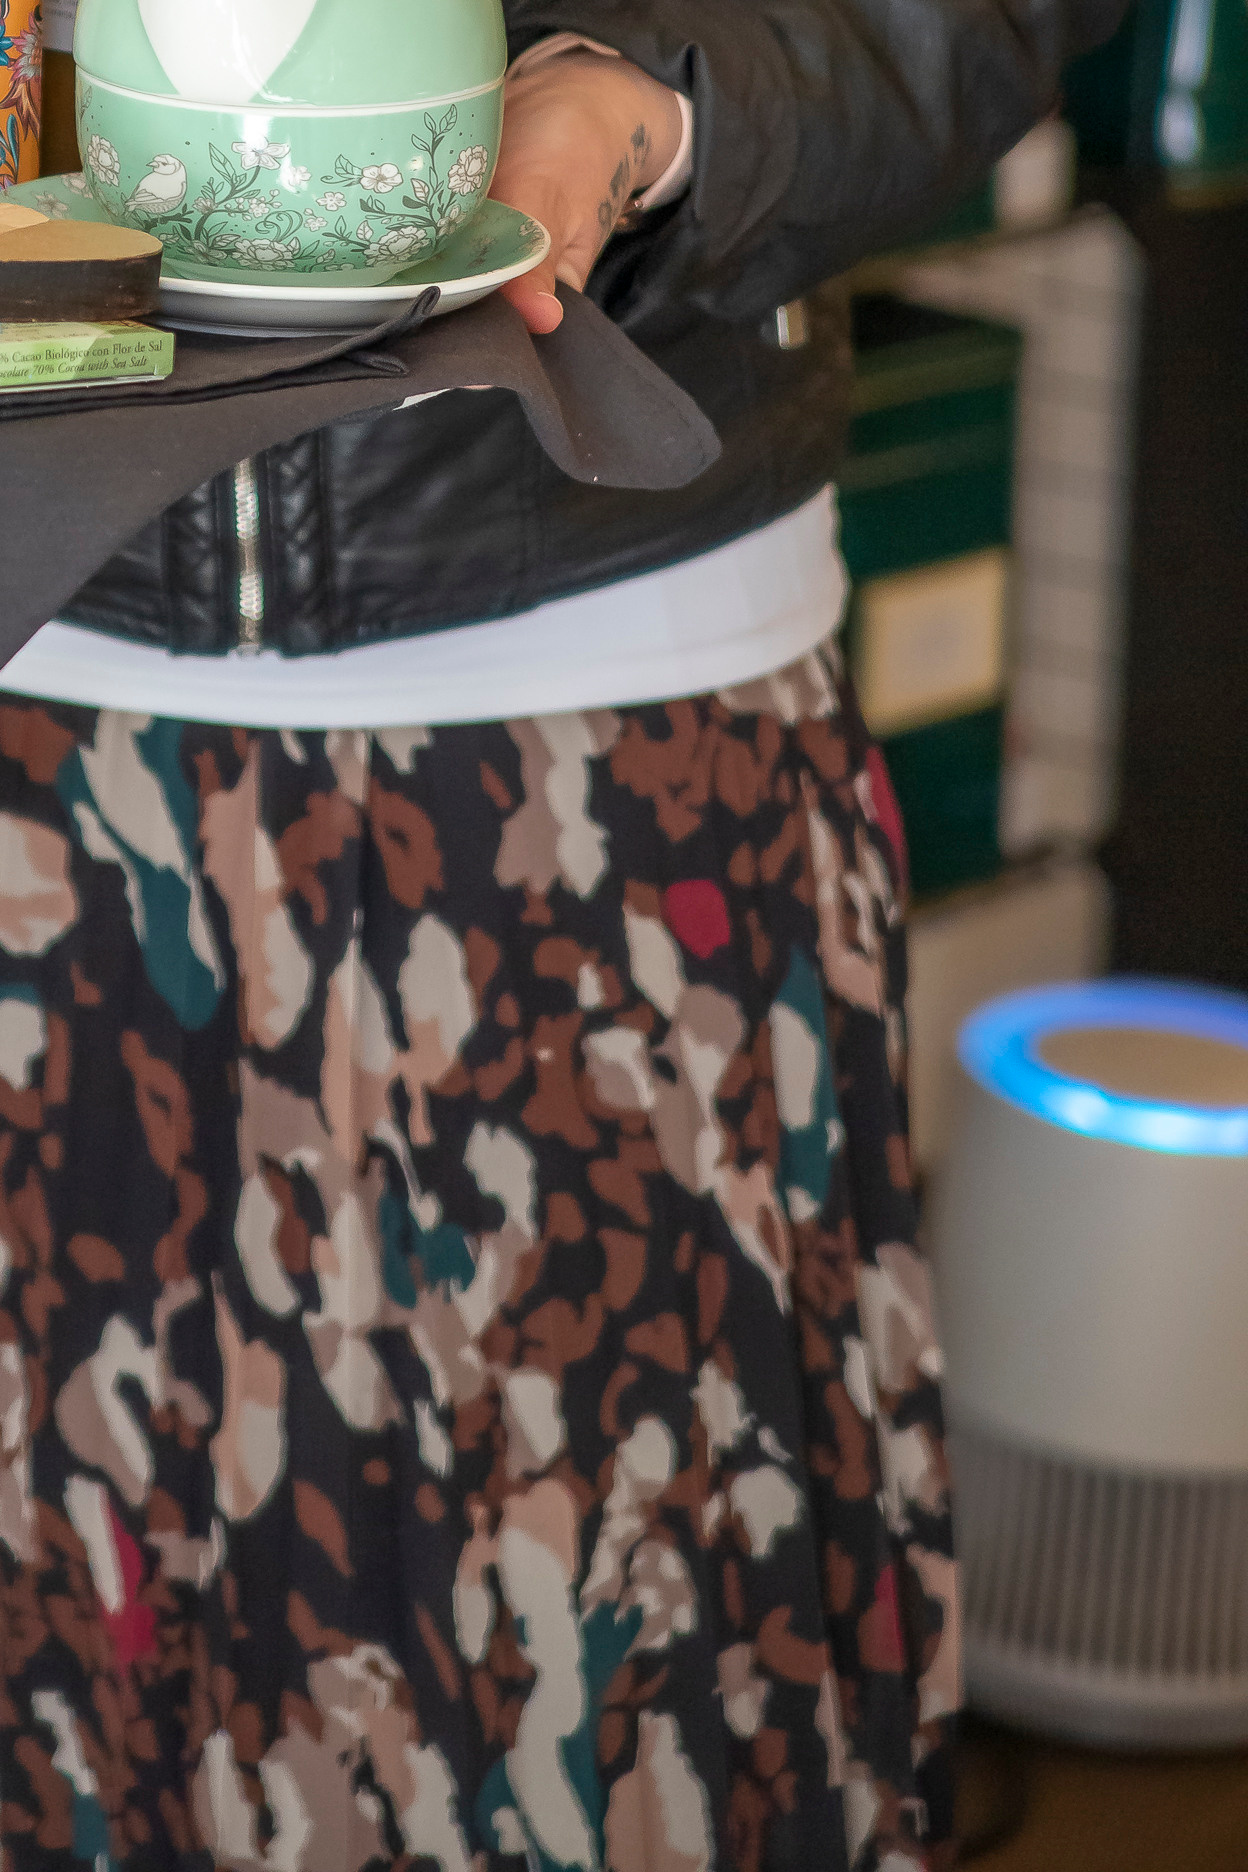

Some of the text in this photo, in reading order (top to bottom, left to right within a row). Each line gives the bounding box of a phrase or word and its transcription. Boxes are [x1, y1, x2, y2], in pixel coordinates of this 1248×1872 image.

[12, 350, 41, 363] Cacao
[44, 348, 90, 362] Biológico
[92, 347, 109, 357] con
[112, 343, 132, 355] Flor
[134, 341, 146, 353] de
[149, 339, 163, 352] Sal
[32, 364, 55, 375] 70%
[58, 362, 85, 374] Cocoa
[87, 358, 109, 371] with
[112, 358, 127, 370] Sea
[129, 355, 148, 368] Salt
